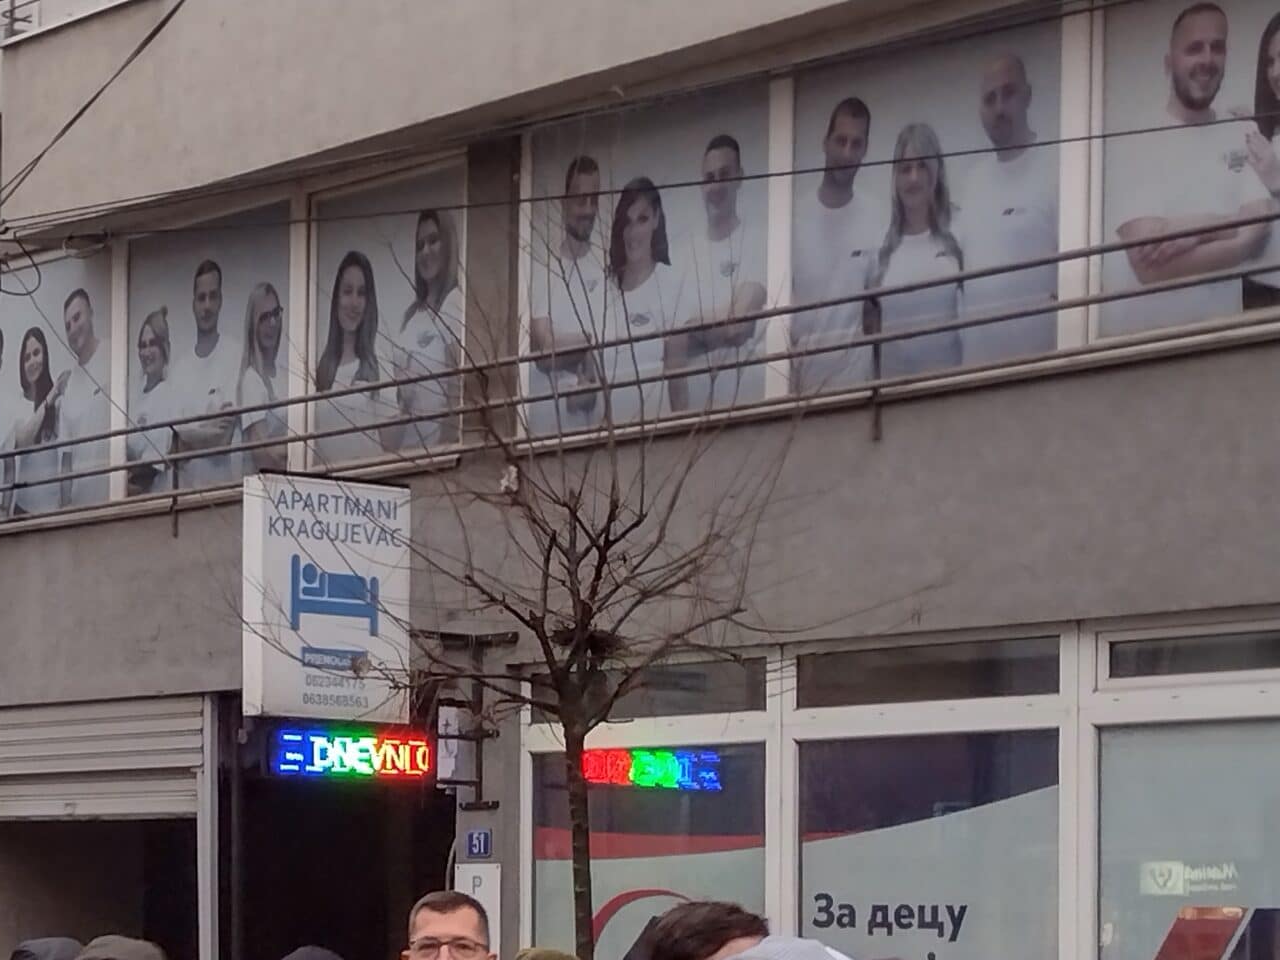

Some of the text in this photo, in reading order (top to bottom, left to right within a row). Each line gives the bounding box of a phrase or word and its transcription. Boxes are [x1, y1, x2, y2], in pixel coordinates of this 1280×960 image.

[275, 489, 398, 520] APARTMANI
[268, 516, 404, 548] KRAGUJEVAC
[471, 832, 485, 854] 51
[812, 892, 968, 942] За децу
